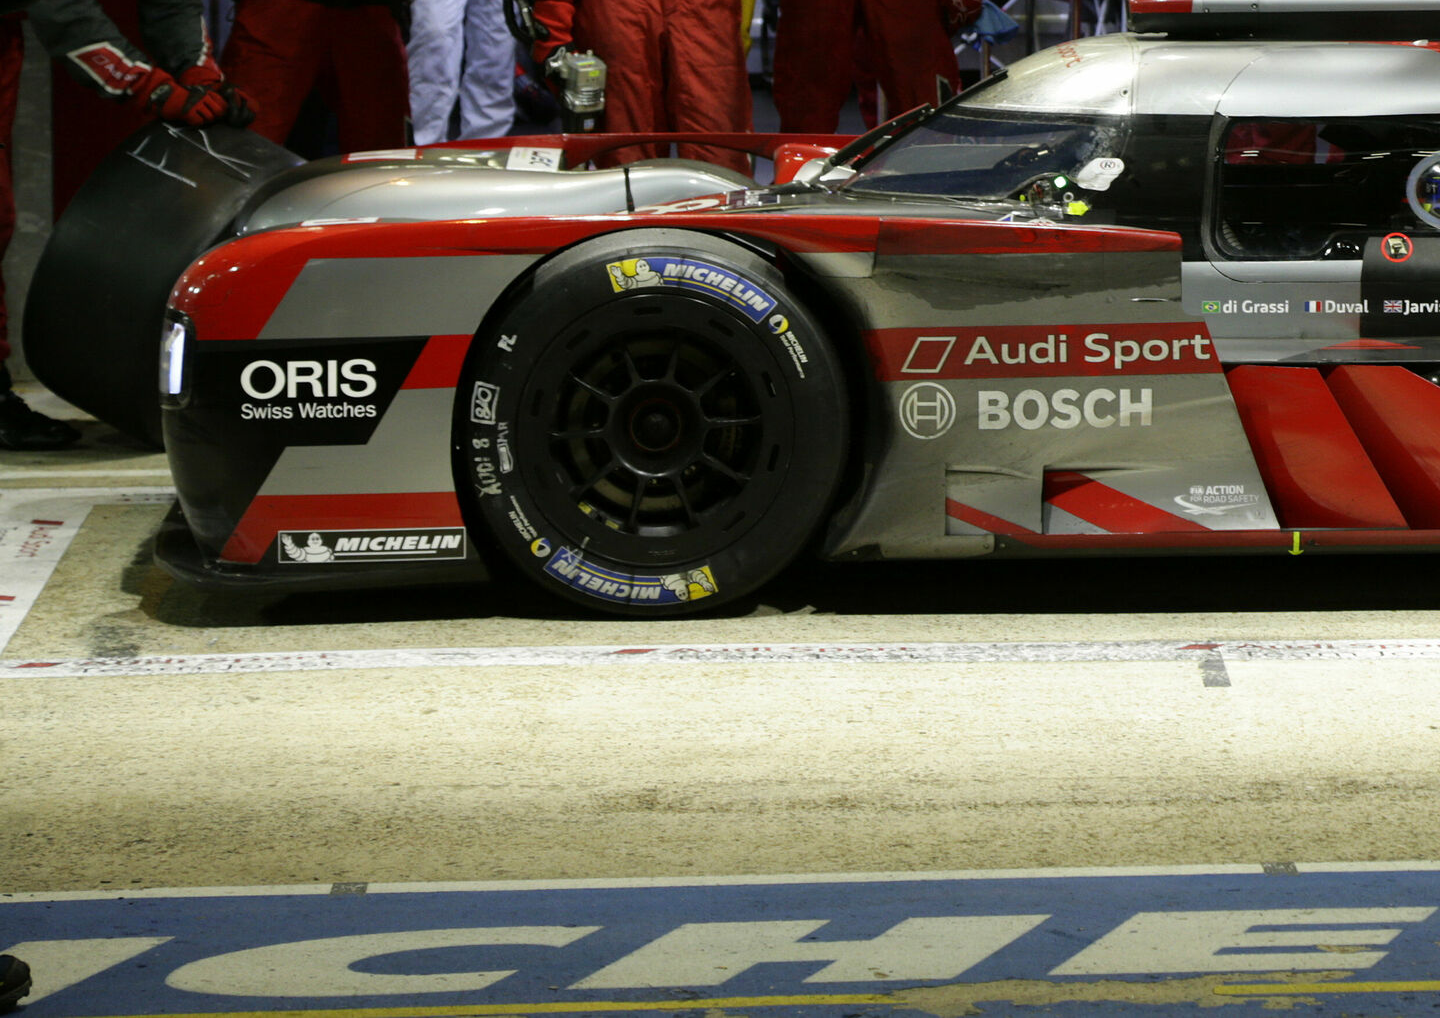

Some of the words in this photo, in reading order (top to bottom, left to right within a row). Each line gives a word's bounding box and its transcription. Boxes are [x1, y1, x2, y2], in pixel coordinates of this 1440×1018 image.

[662, 262, 770, 312] MICHELIN
[1223, 300, 1238, 314] di
[1241, 300, 1290, 314] Grassi
[1325, 300, 1369, 314] Duval
[964, 334, 1068, 365] Audi
[1084, 333, 1211, 370] Sport
[240, 358, 377, 400] ORIS
[240, 402, 294, 419] Swiss
[298, 401, 377, 419] Watches
[978, 388, 1153, 431] BOSCH
[1203, 495, 1227, 503] ROAD
[1227, 494, 1260, 503] SAFETY
[1205, 485, 1244, 495] ACTION
[334, 534, 462, 552] MICHELIN
[551, 556, 661, 600] MICHELIN
